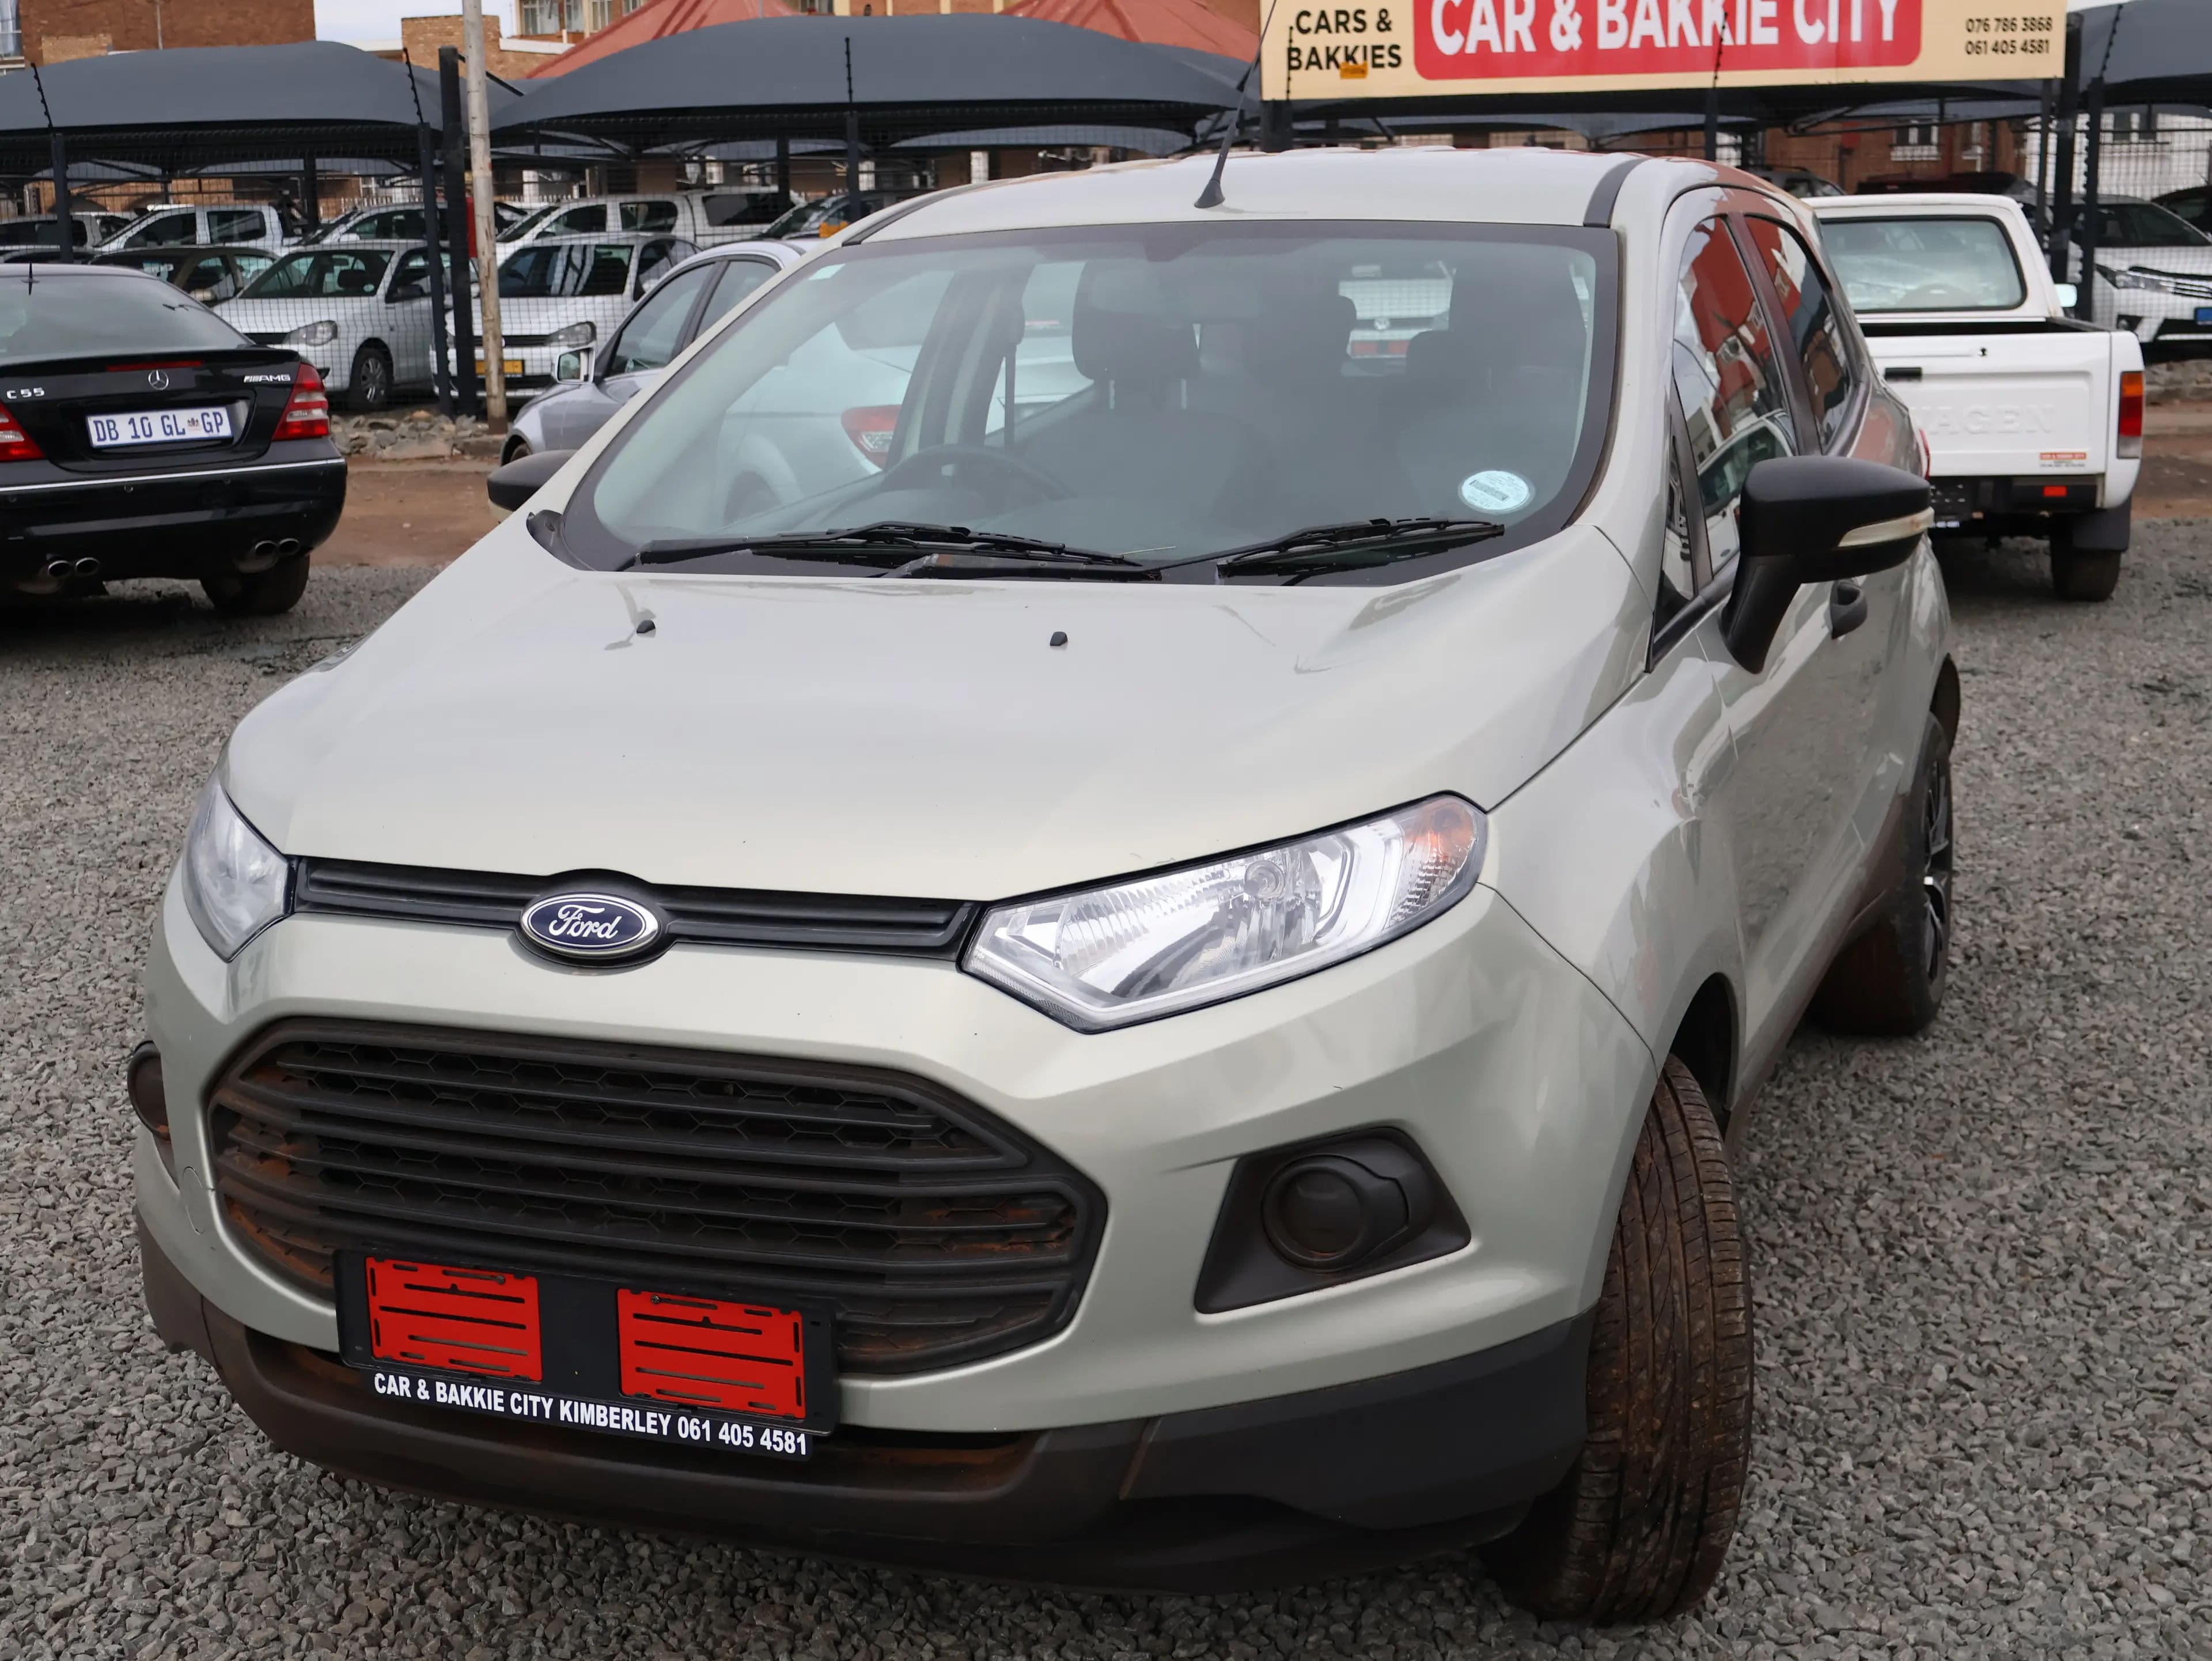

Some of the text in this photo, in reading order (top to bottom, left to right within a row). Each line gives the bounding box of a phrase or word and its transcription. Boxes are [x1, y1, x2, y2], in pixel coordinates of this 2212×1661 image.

[1296, 8, 1392, 35] CARS &
[1431, 0, 1537, 55] CAR
[1550, 0, 1582, 51] &
[1597, 0, 1779, 50] BAKKIE
[1965, 18, 1990, 32] 076
[1994, 17, 2017, 32] 786
[1287, 44, 1402, 70] BAKKIES
[1965, 39, 2050, 55] 061 405 4581
[259, 374, 291, 383] AMG
[20, 387, 44, 398] 55
[93, 411, 224, 442] DB 10 GL GP
[548, 904, 622, 939] Ford
[374, 1373, 806, 1455] CAR & BAKKIE CITY KIMBERLEY 061 405 4581
